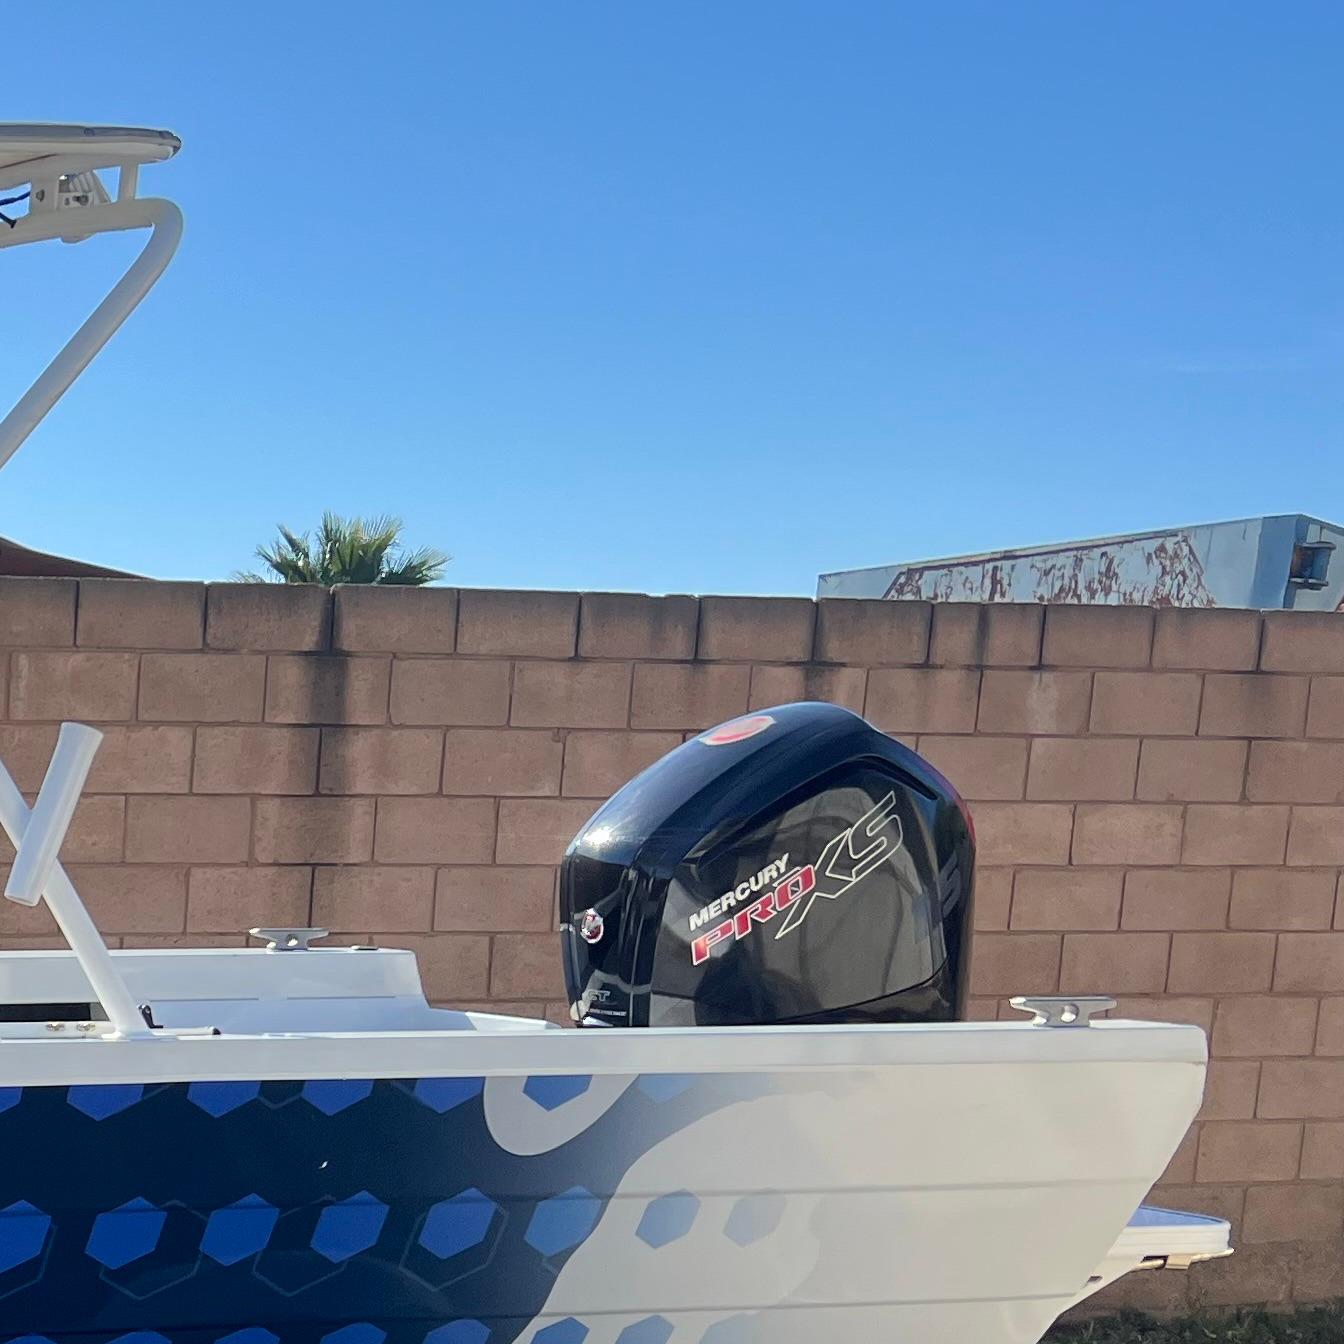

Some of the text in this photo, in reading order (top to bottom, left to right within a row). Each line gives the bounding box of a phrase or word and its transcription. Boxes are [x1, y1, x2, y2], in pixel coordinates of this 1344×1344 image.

[688, 853, 790, 932] MERCURY
[691, 790, 904, 966] PRO XS
